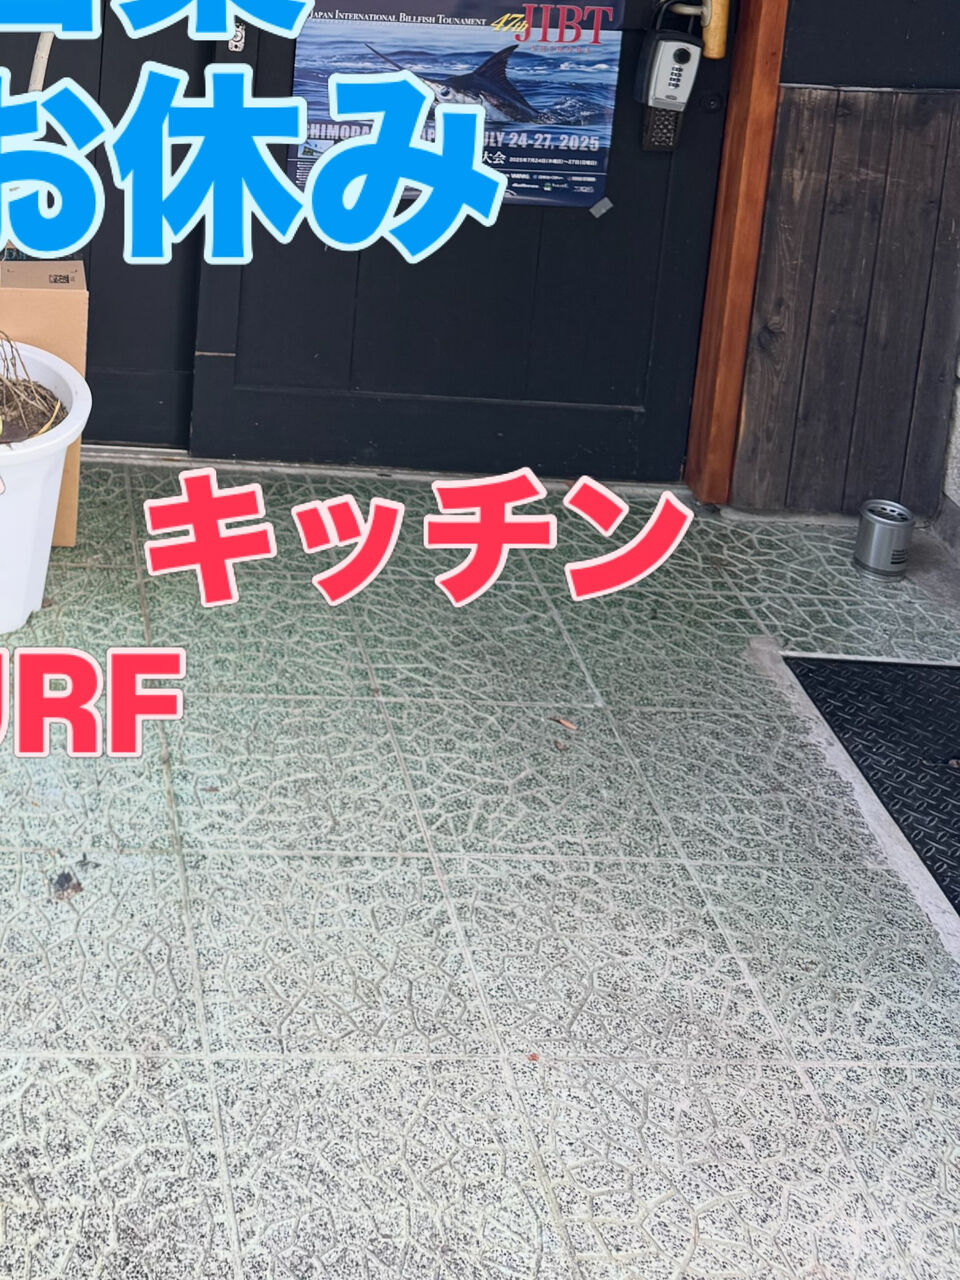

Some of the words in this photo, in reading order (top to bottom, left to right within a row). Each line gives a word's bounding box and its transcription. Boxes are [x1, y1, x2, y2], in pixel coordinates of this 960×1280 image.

[309, 9, 334, 20] JAPAN
[335, 9, 398, 23] INTERNATIONAL
[514, 3, 613, 45] JIBT
[307, 122, 371, 140] HIMODA
[508, 132, 555, 150] 24-27,
[558, 134, 600, 151] 2025
